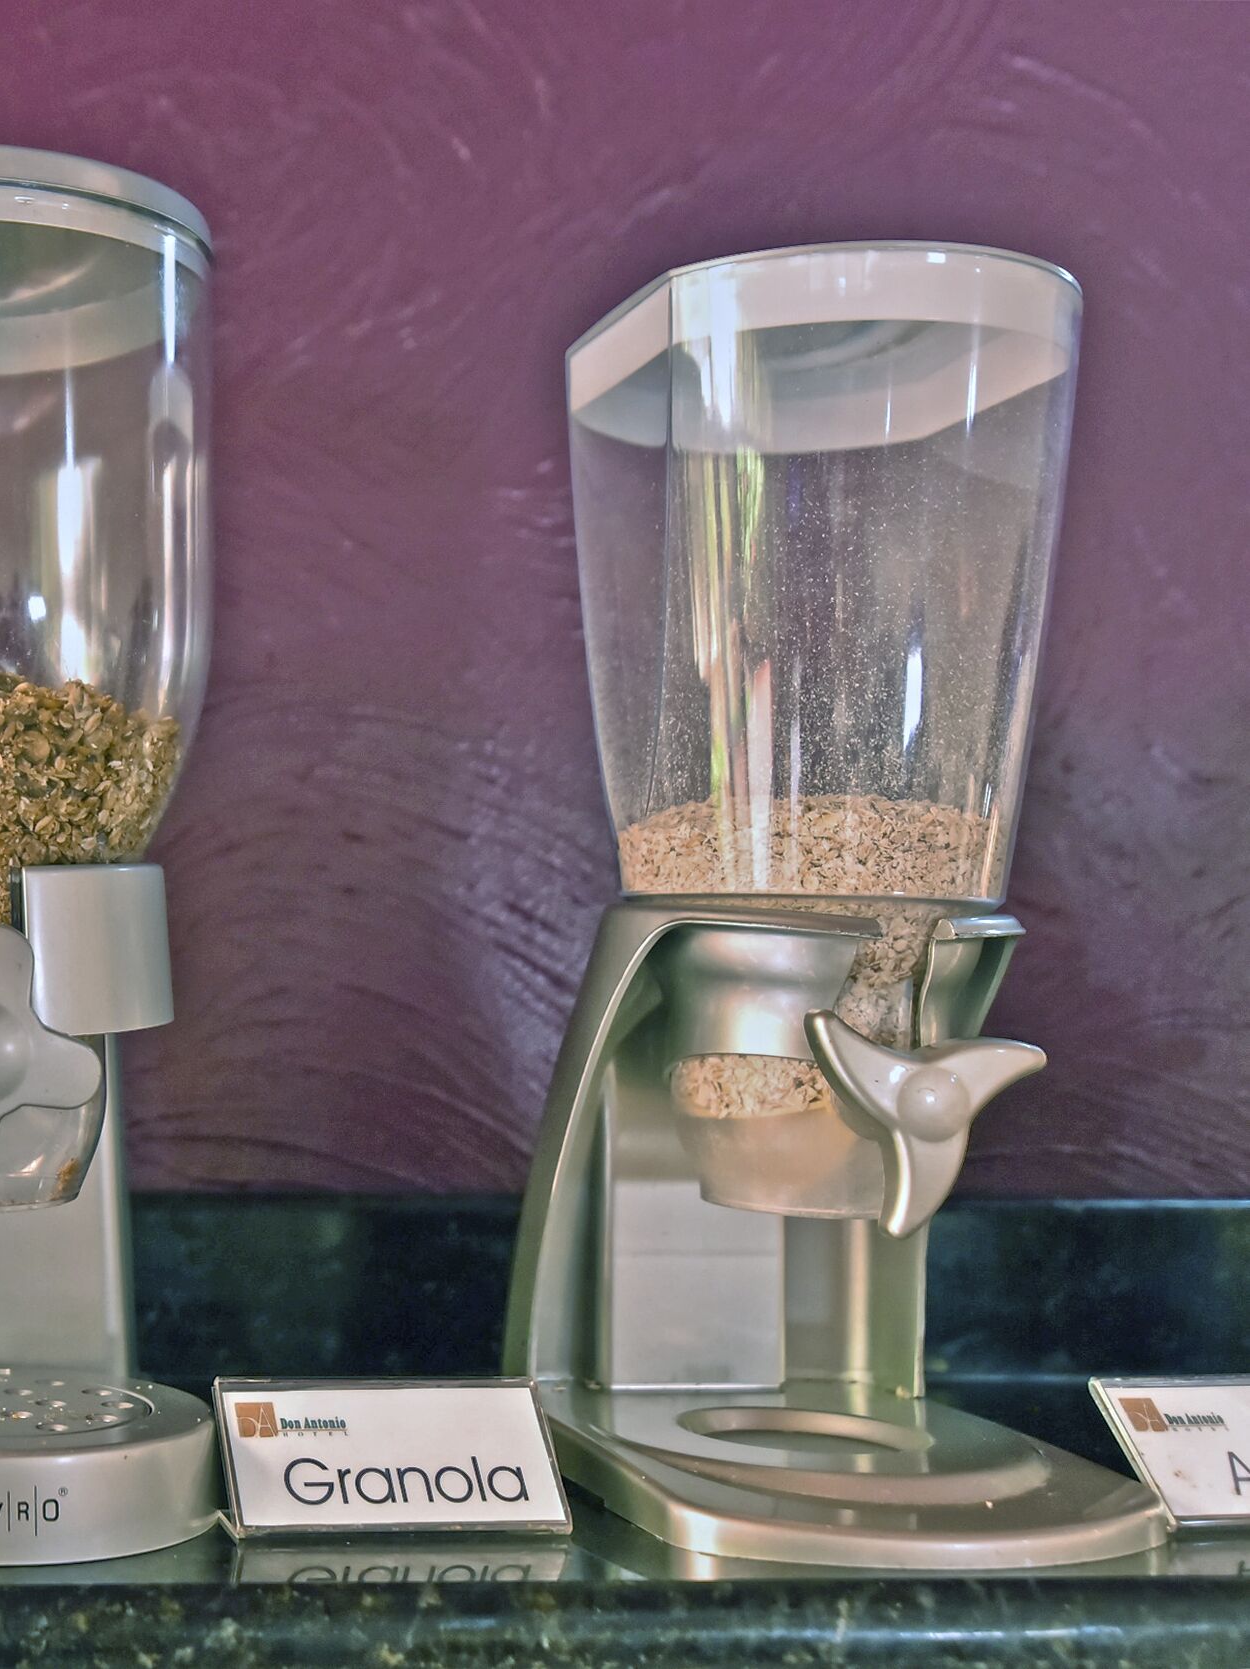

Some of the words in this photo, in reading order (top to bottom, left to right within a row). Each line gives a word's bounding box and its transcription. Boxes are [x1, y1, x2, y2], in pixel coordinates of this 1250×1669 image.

[280, 1417, 301, 1429] Don
[303, 1416, 347, 1429] Antonio
[1164, 1412, 1184, 1425] Don
[1184, 1411, 1225, 1425] Antonio
[283, 1456, 530, 1505] Granola
